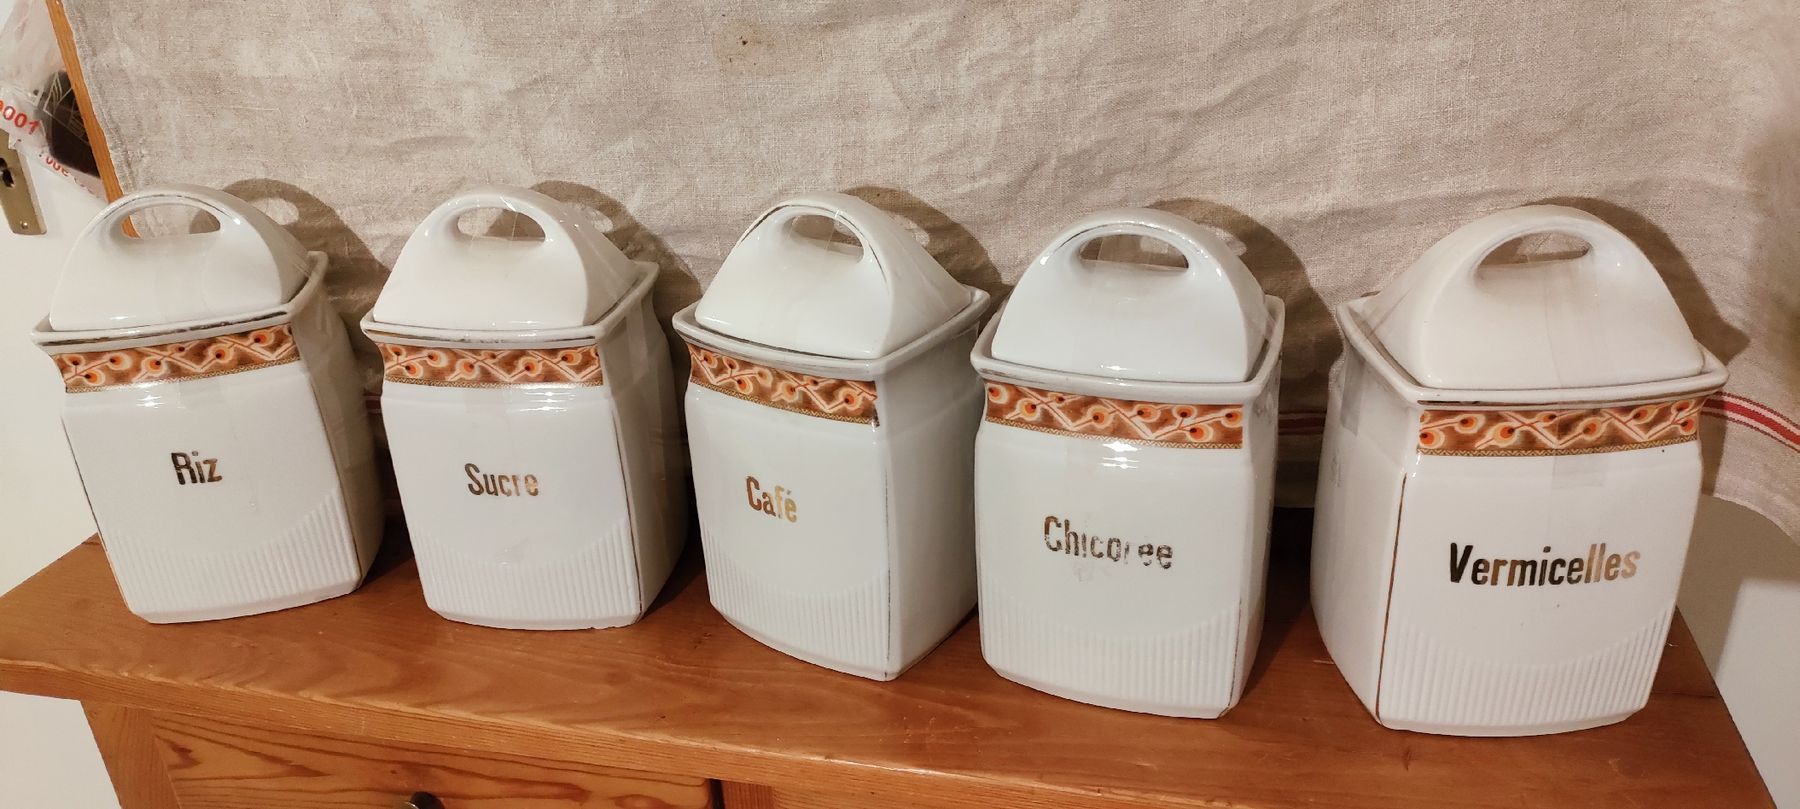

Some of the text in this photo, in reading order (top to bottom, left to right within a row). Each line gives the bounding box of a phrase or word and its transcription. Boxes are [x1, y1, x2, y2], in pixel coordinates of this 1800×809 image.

[171, 450, 223, 485] Riz
[464, 462, 539, 497] Sucre
[746, 475, 797, 523] Café
[1449, 542, 1641, 587] Vermicelles
